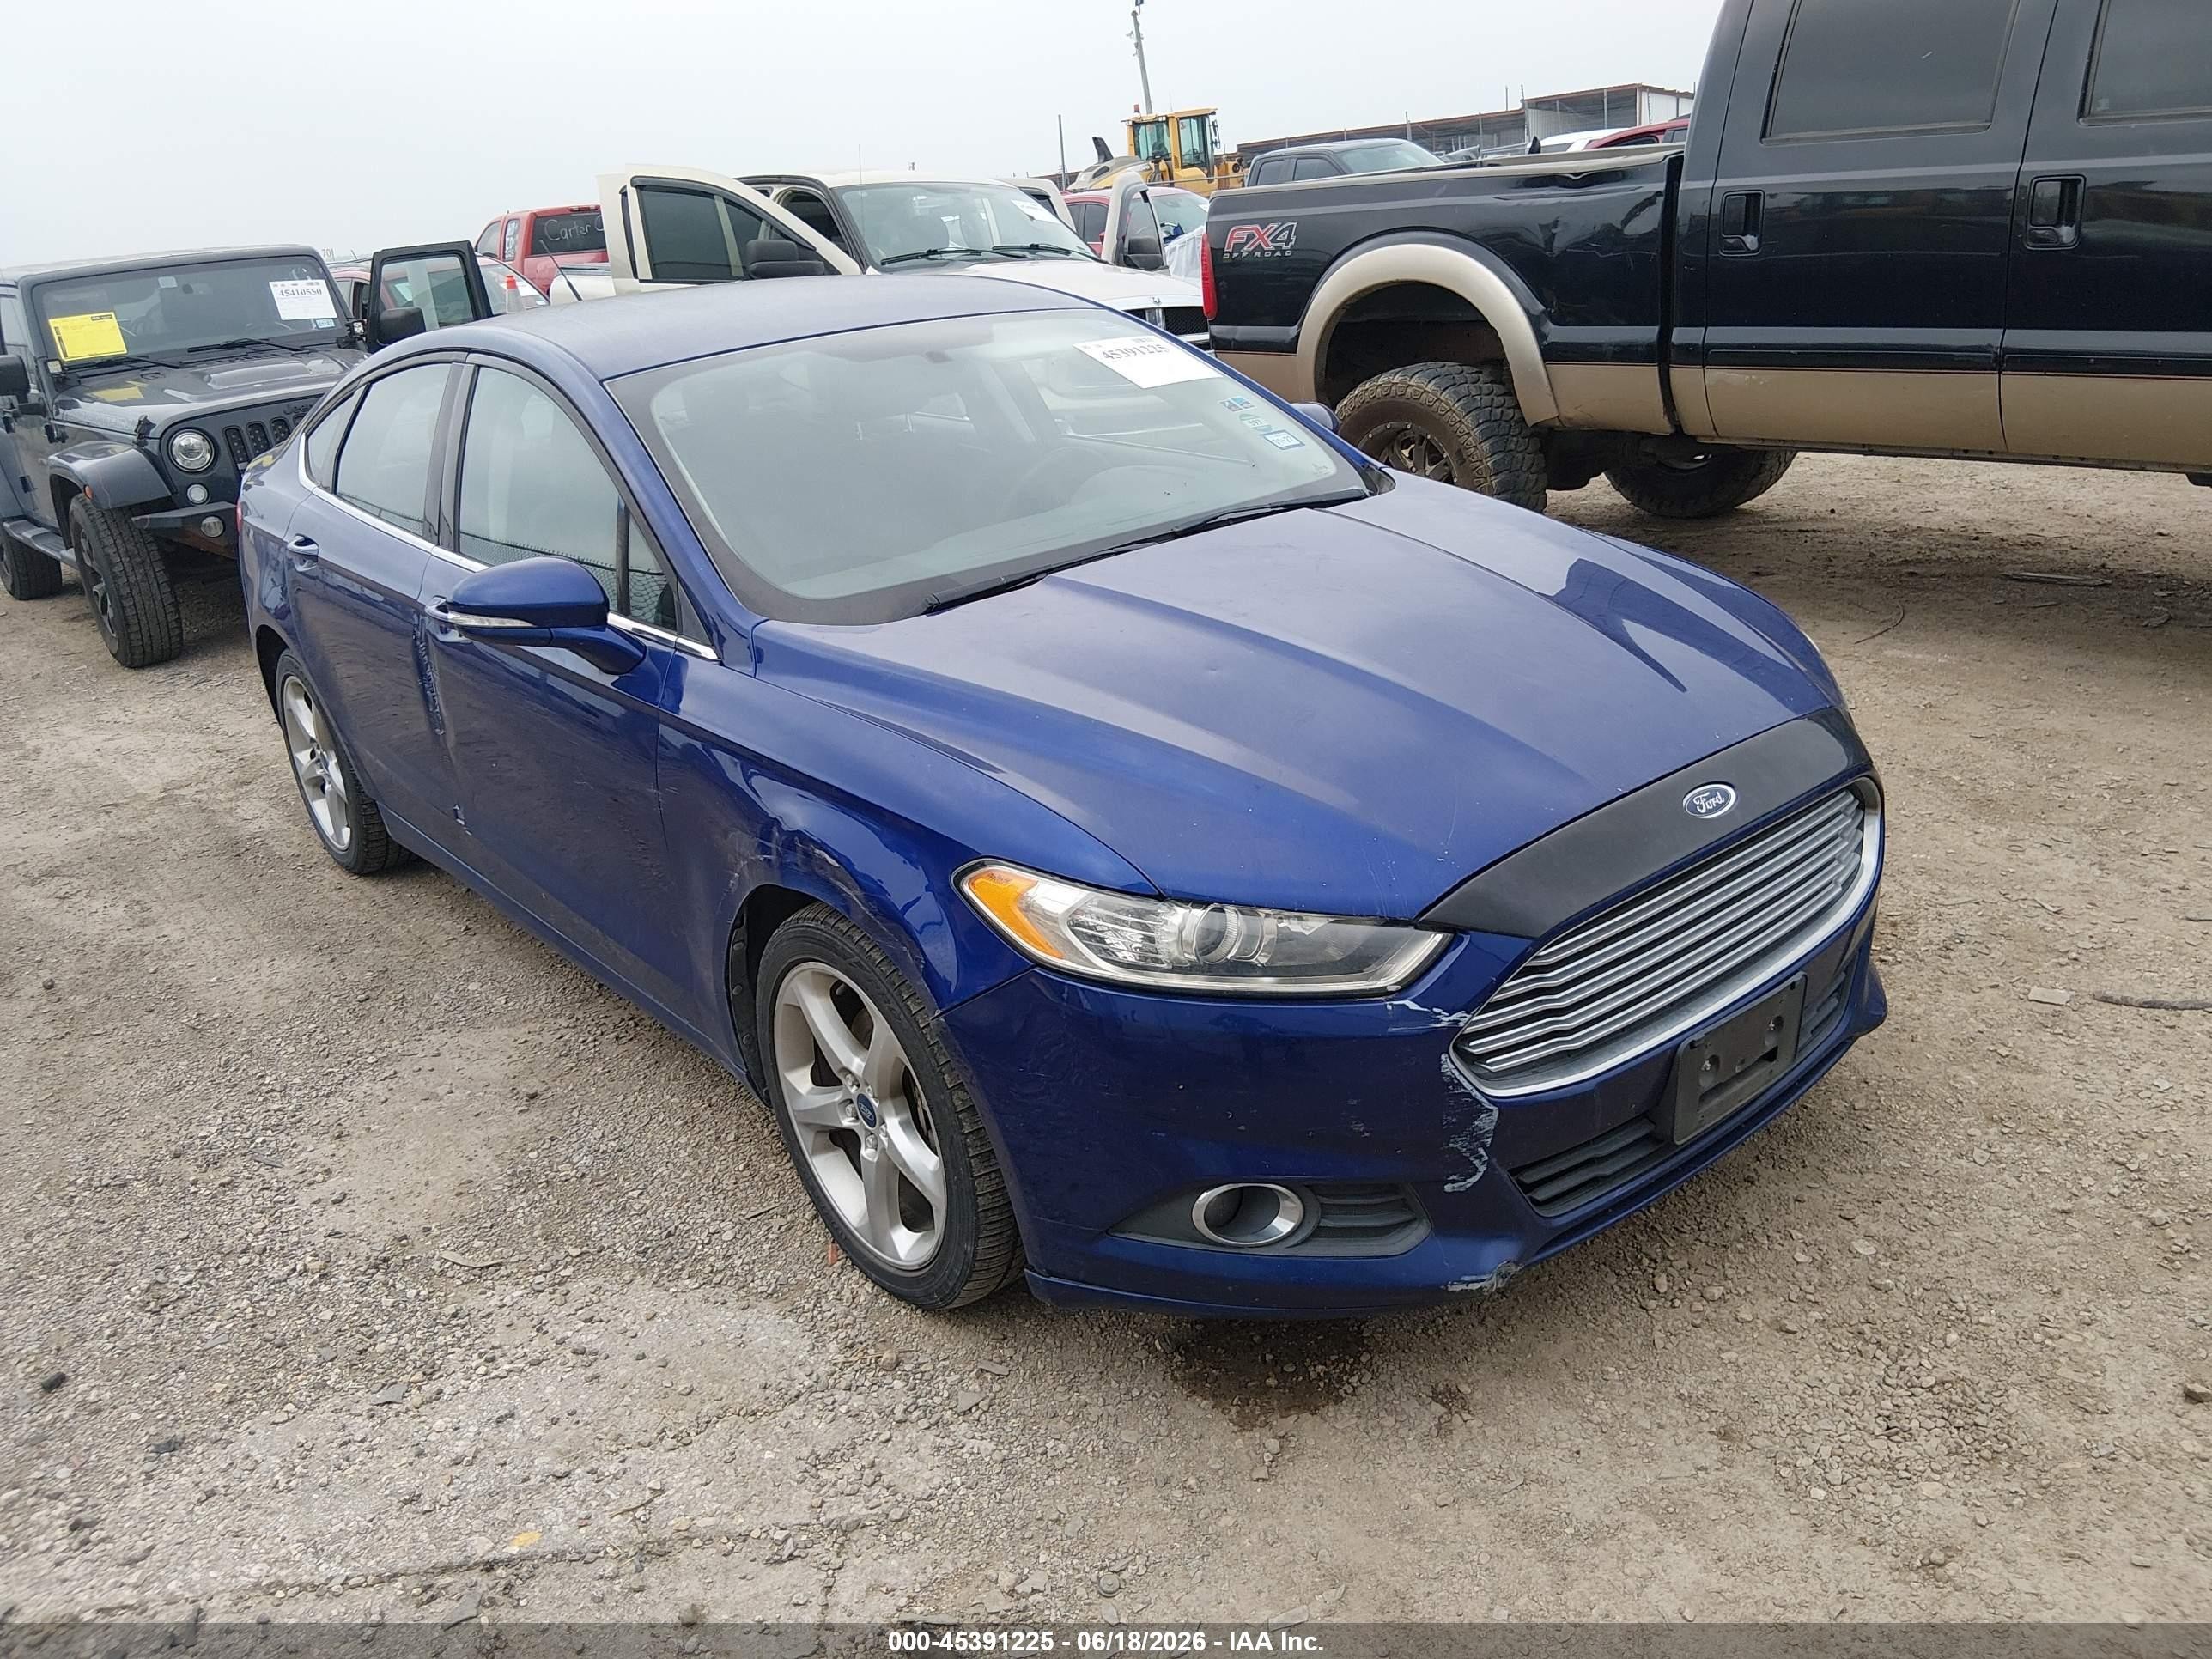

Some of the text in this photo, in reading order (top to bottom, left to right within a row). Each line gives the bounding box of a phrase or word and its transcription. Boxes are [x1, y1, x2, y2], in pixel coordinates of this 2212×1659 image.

[544, 219, 591, 241] Carter
[1224, 221, 1298, 253] FX4
[1223, 249, 1293, 260] OFF ROAD
[279, 288, 322, 297] 45410550
[1103, 344, 1170, 360] 45391225
[1693, 792, 1724, 813] Ford
